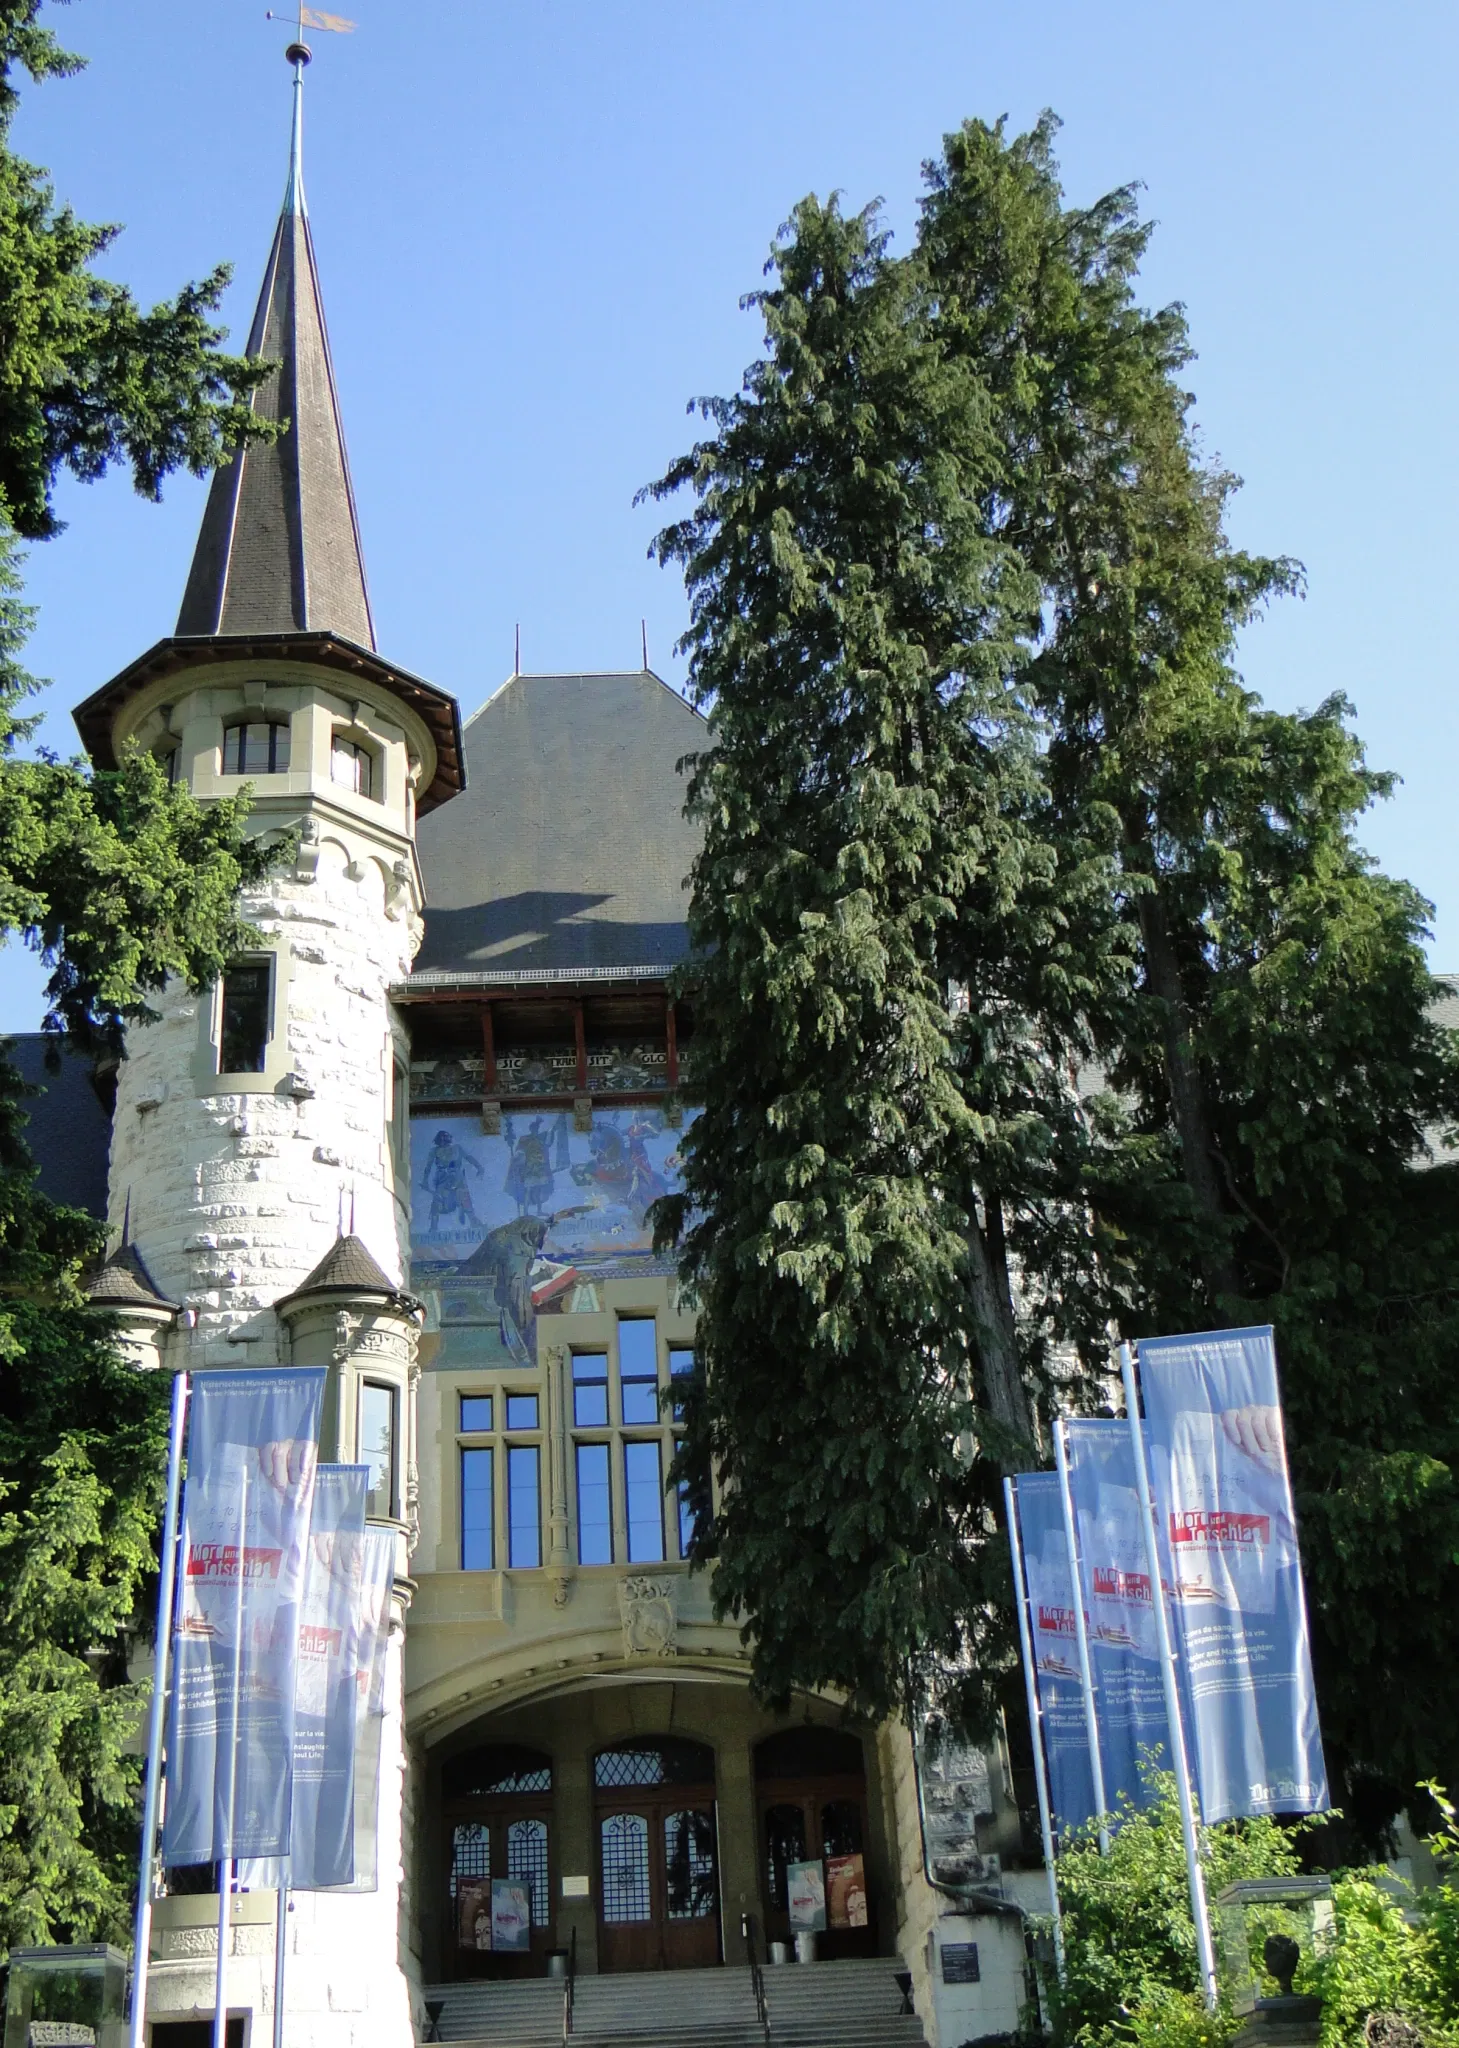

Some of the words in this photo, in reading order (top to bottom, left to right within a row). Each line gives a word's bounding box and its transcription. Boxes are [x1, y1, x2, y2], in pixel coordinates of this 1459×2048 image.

[502, 1058, 521, 1069] SIC
[1175, 1511, 1208, 1529] Mord
[1210, 1513, 1226, 1525] und
[1188, 1523, 1262, 1544] Totschlag
[192, 1544, 222, 1561] Mord
[1248, 1783, 1276, 1800] Der
[1277, 1779, 1320, 1799] Bund
